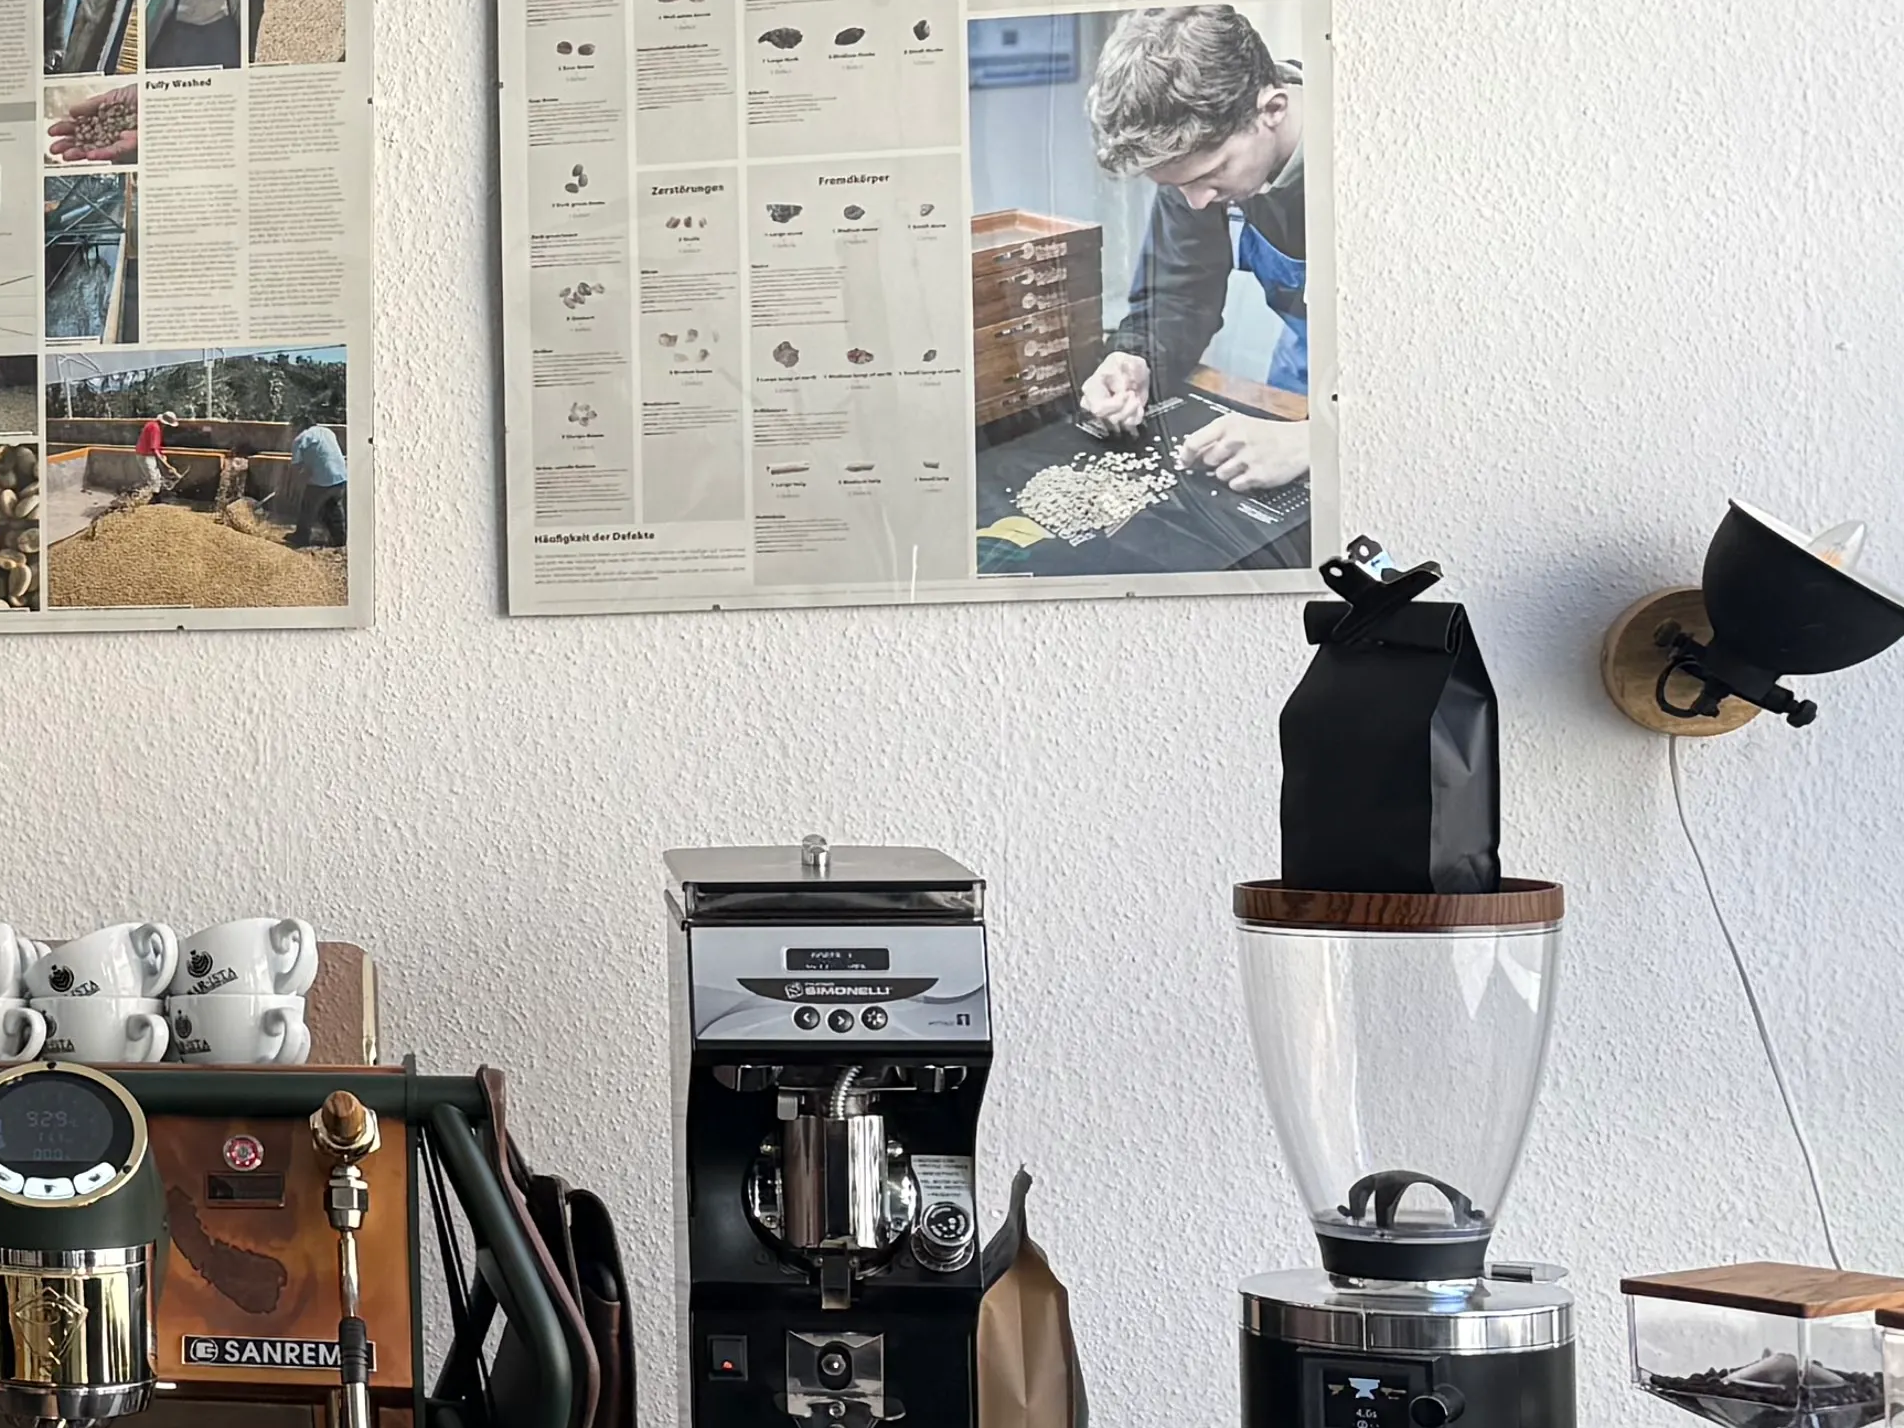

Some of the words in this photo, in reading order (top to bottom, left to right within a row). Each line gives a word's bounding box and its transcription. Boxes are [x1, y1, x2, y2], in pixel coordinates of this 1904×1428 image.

[818, 173, 890, 188] Fremdkörper
[651, 183, 724, 196] Zerstörungen
[534, 531, 590, 545] Häufigkeit
[592, 531, 610, 542] der
[612, 529, 655, 542] Defekte
[805, 985, 890, 996] SIMONELLI
[224, 1339, 341, 1366] SANREM
